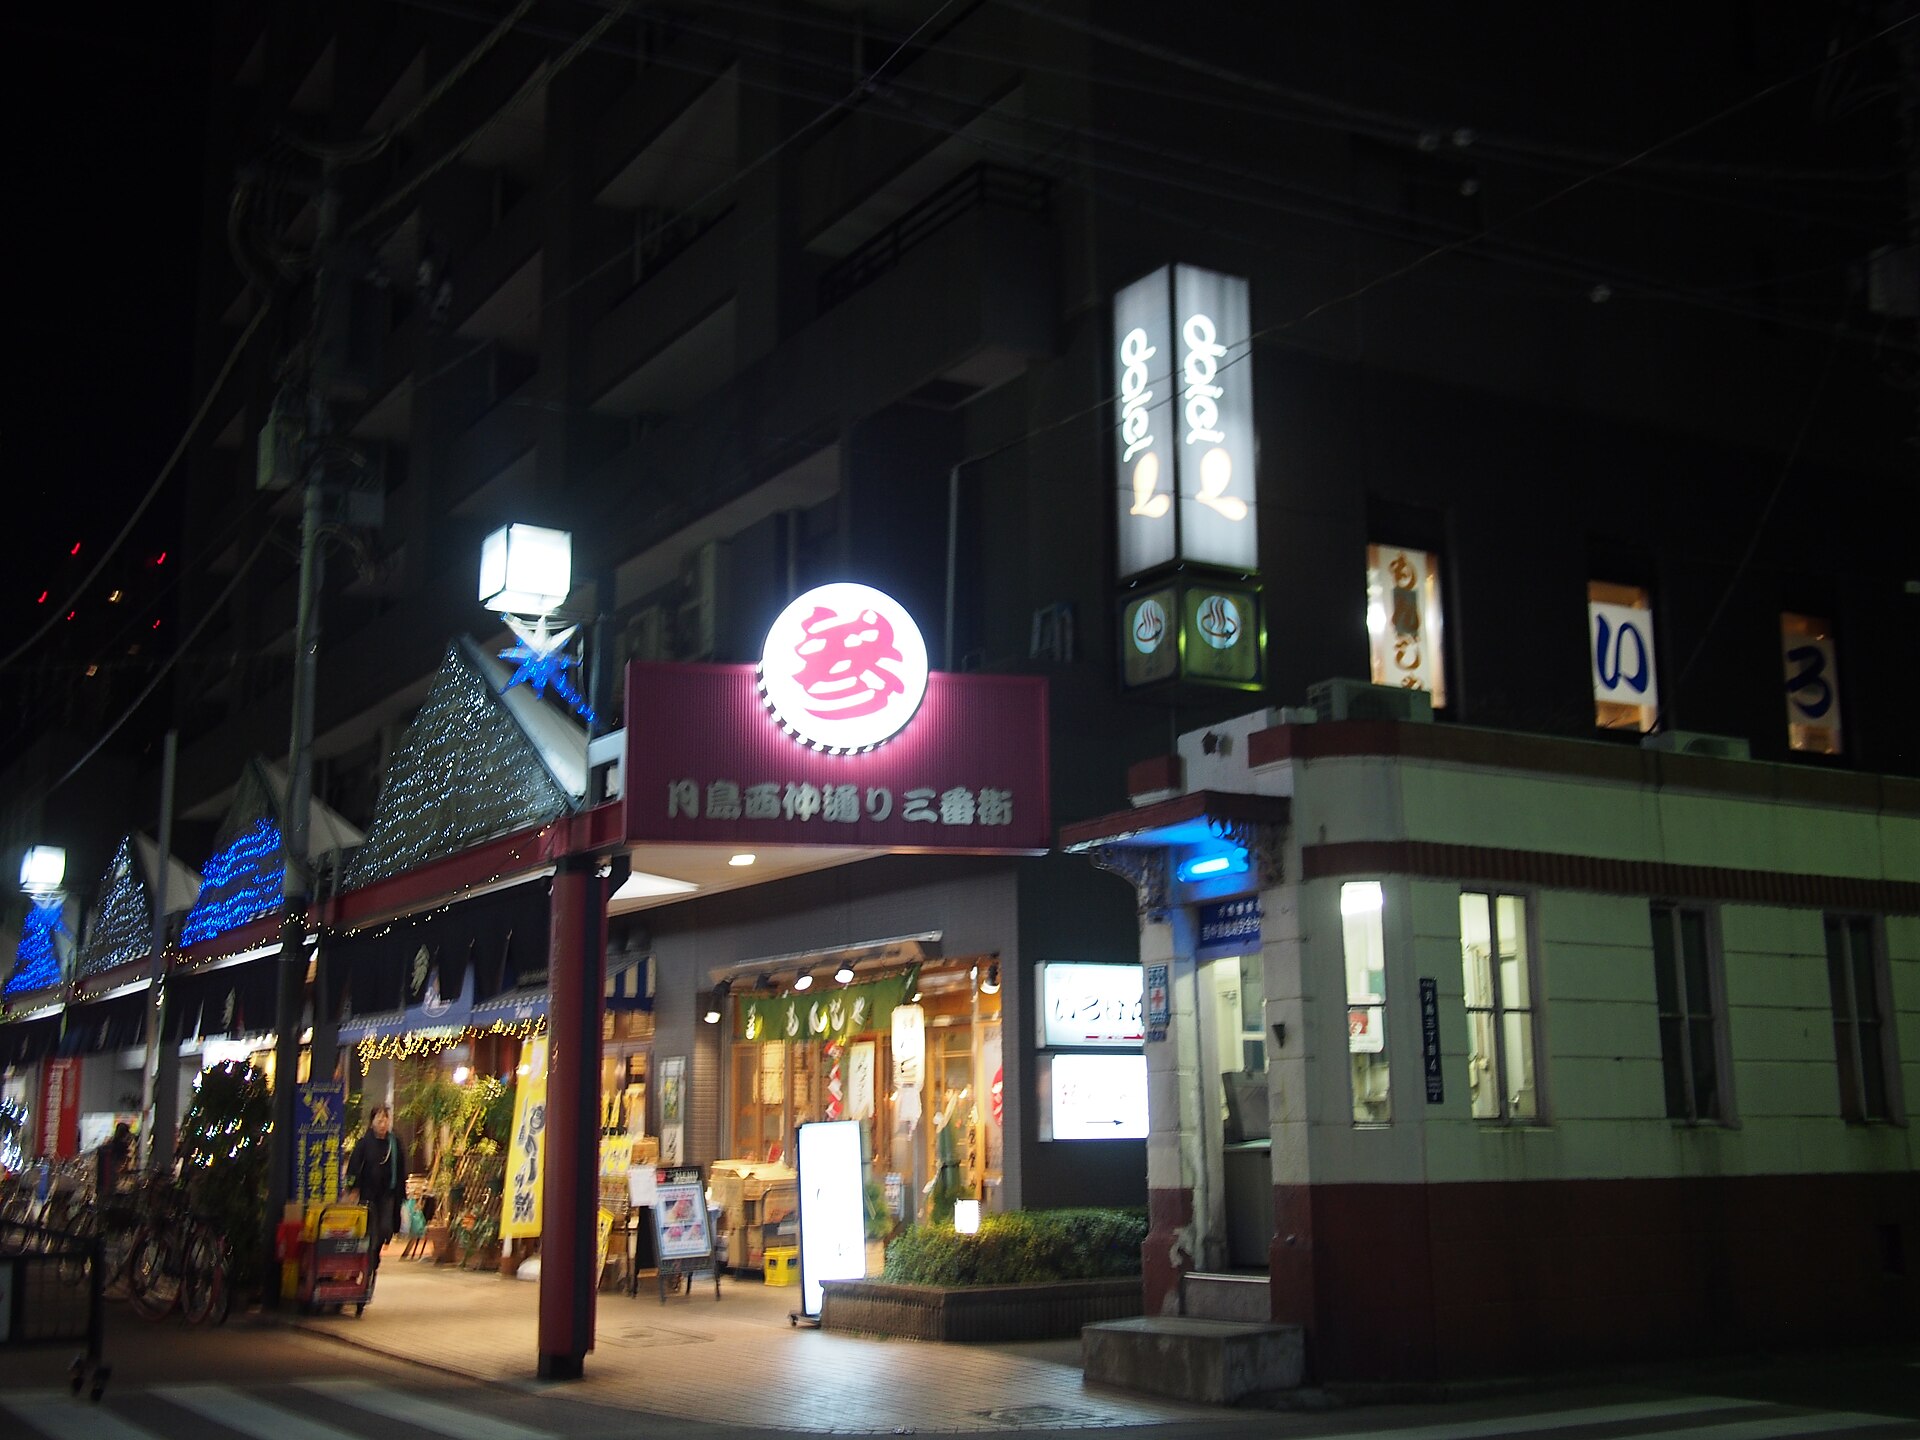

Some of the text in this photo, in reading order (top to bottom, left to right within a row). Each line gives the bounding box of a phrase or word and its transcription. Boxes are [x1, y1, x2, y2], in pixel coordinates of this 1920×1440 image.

[1594, 613, 1649, 694] い
[1785, 644, 1832, 719] ろ
[667, 780, 1014, 826] 月島西仲通り三番街
